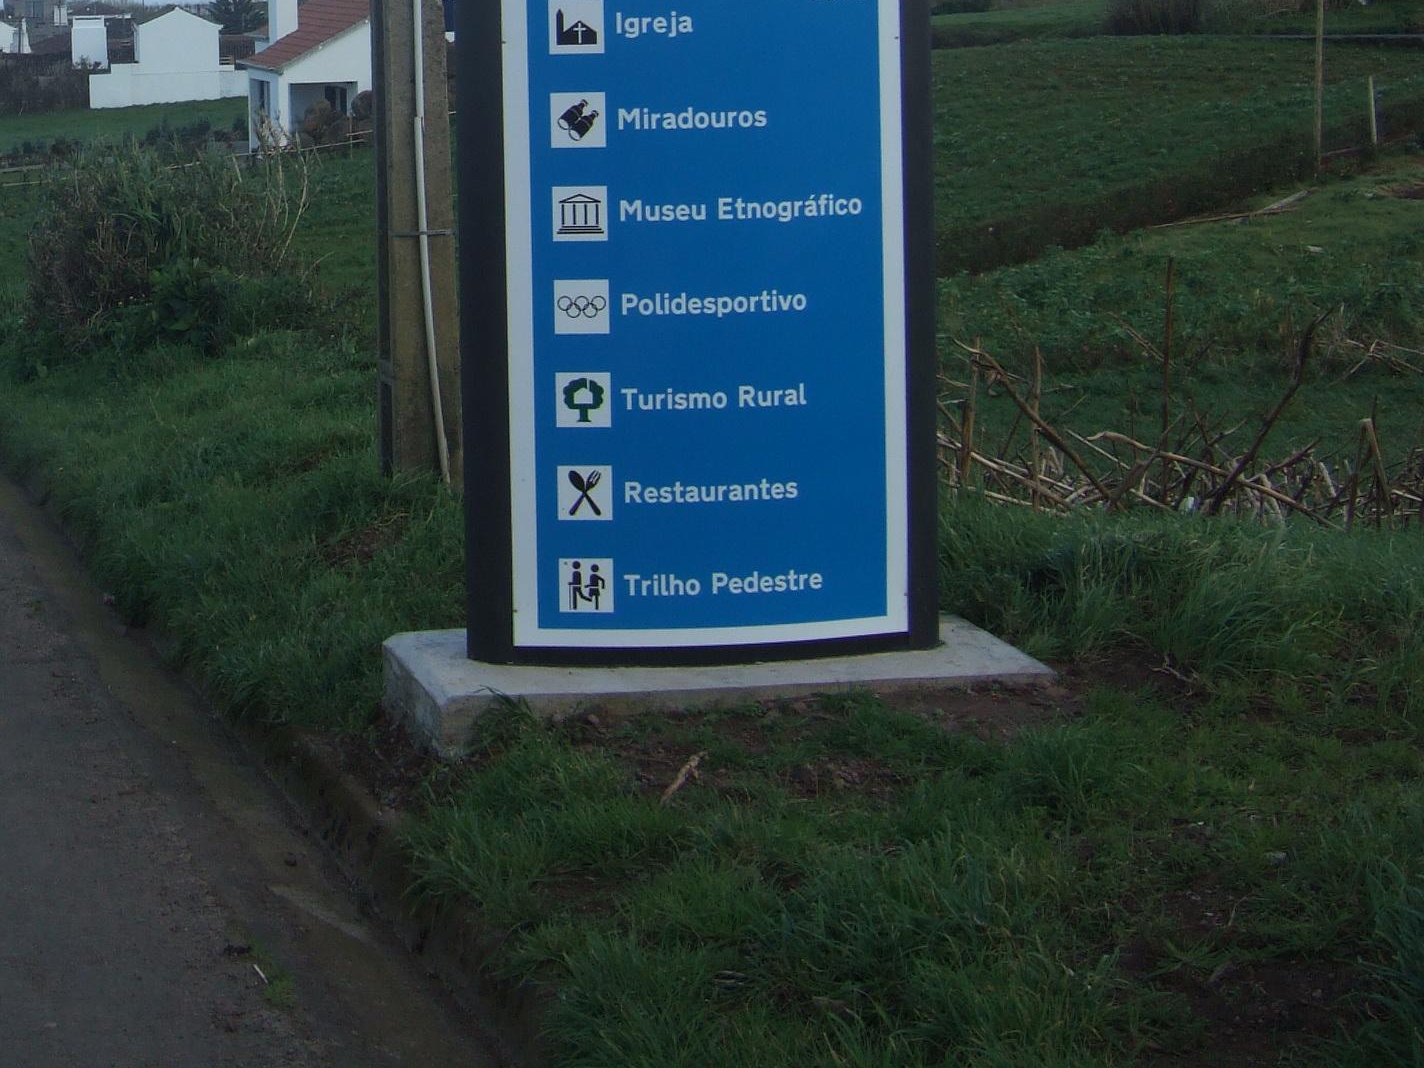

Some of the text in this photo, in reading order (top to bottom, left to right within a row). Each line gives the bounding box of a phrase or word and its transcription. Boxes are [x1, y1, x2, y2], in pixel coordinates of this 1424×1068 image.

[616, 12, 693, 37] Igreja
[618, 107, 767, 130] Miradouros
[619, 194, 862, 222] Museu Etnográfico
[621, 290, 807, 317] Polidesportivo
[621, 383, 806, 410] Turismo Rural
[625, 478, 798, 503] Restaurantes
[624, 570, 823, 597] Trilho Pedestre
